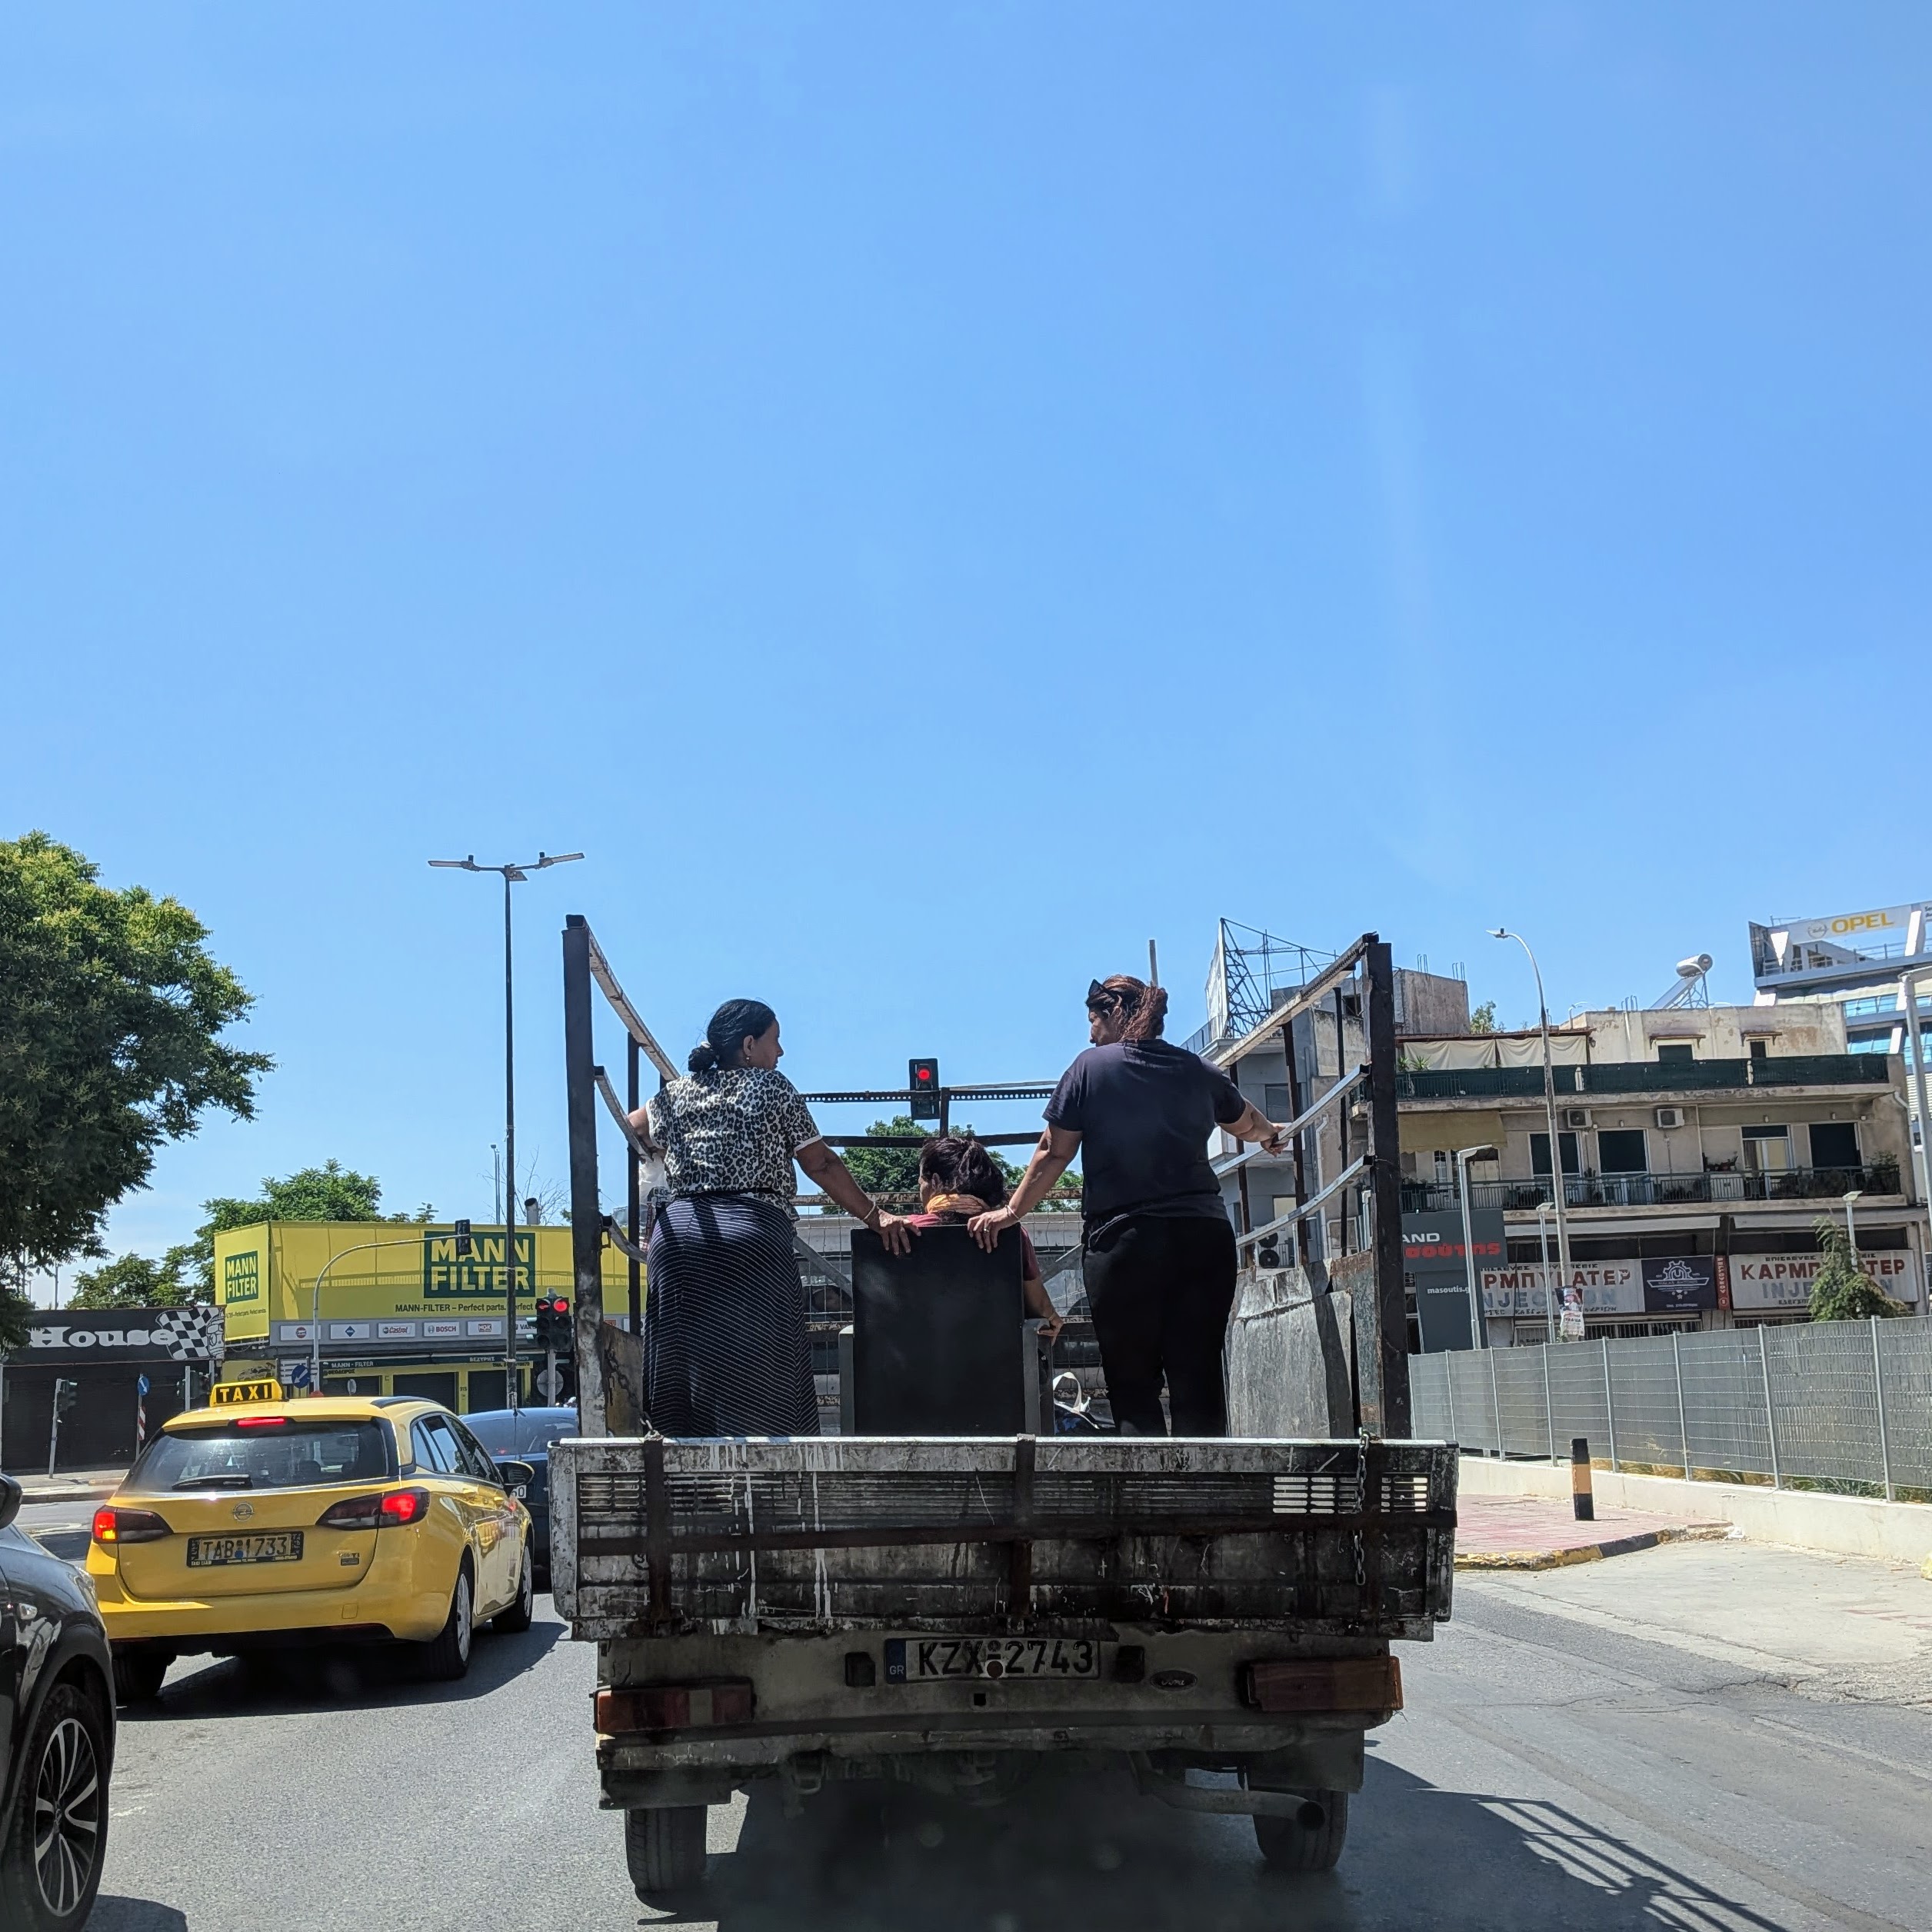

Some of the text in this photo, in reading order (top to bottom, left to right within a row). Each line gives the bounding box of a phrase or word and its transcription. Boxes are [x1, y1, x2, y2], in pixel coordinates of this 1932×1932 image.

[1831, 912, 1895, 934] OPEL
[431, 1238, 529, 1262] MANN
[226, 1255, 257, 1278] MANN
[226, 1276, 257, 1298] FILTER
[431, 1266, 530, 1290] FILTER
[1427, 1285, 1471, 1294] masoutis.g
[395, 1304, 451, 1312] MANN-FILTER
[458, 1303, 485, 1311] Perfect
[486, 1304, 506, 1313] parts.
[515, 1302, 534, 1311] erfect
[29, 1326, 176, 1347] House
[219, 1387, 269, 1403] TAXI
[889, 1664, 904, 1675] GR
